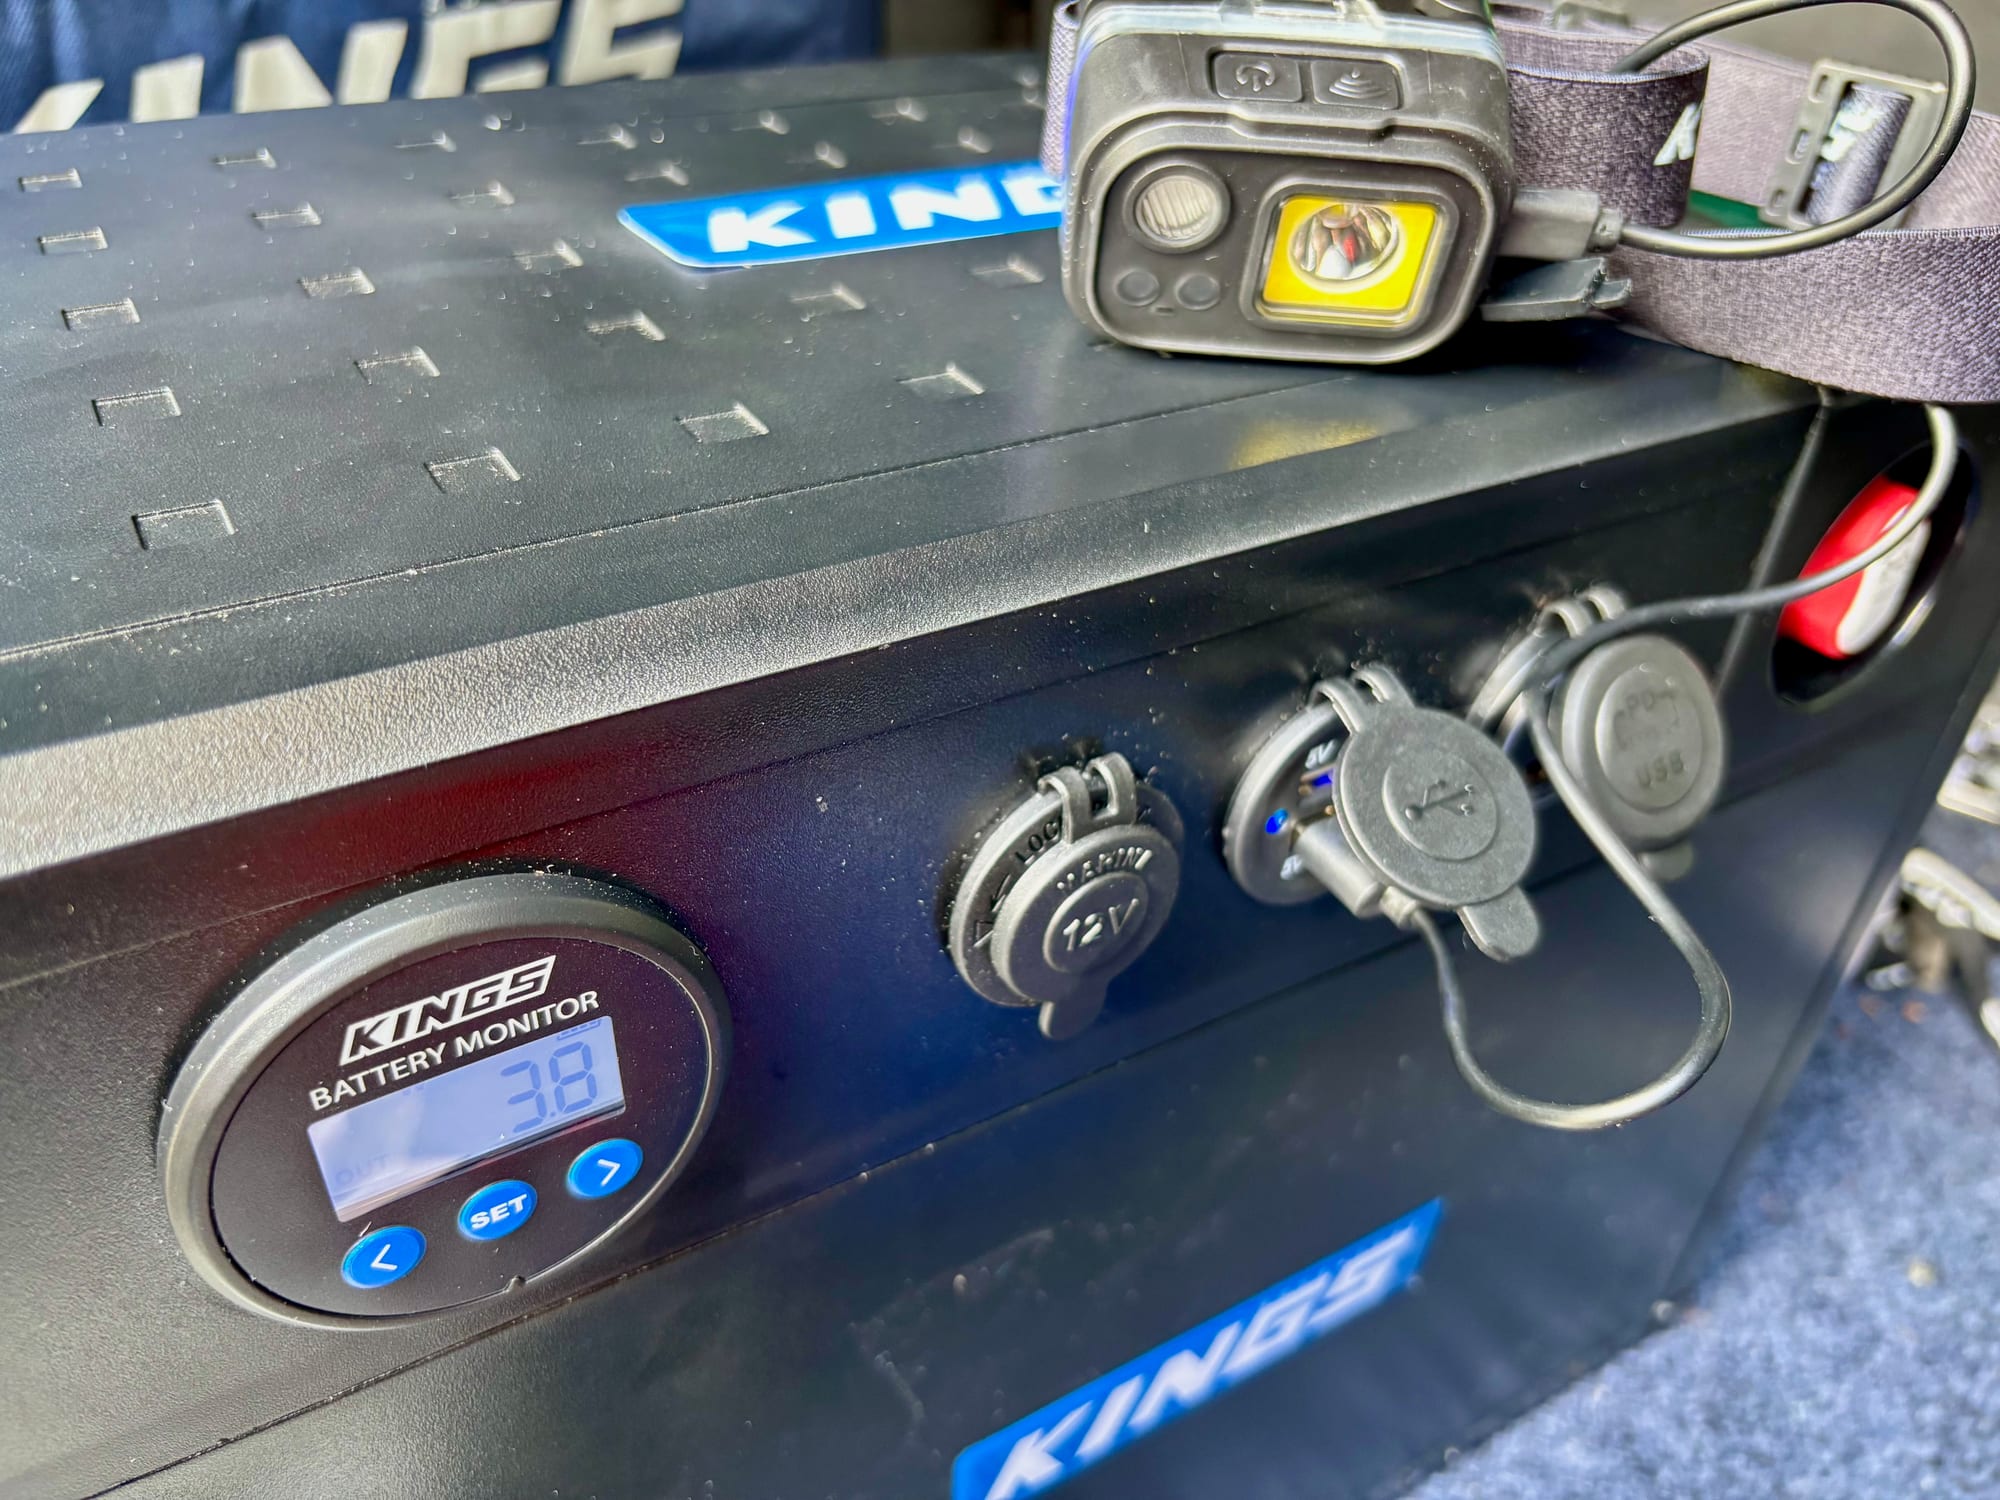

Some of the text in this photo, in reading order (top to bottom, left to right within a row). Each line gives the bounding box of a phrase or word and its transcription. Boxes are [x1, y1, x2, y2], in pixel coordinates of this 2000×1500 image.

[1015, 815, 1064, 867] LOC
[308, 989, 600, 1111] BATTERY MONITOR
[339, 954, 557, 1066] KINGS
[500, 1041, 599, 1134] 3.8
[469, 1193, 528, 1230] SET
[984, 1221, 1417, 1500] KINGS
